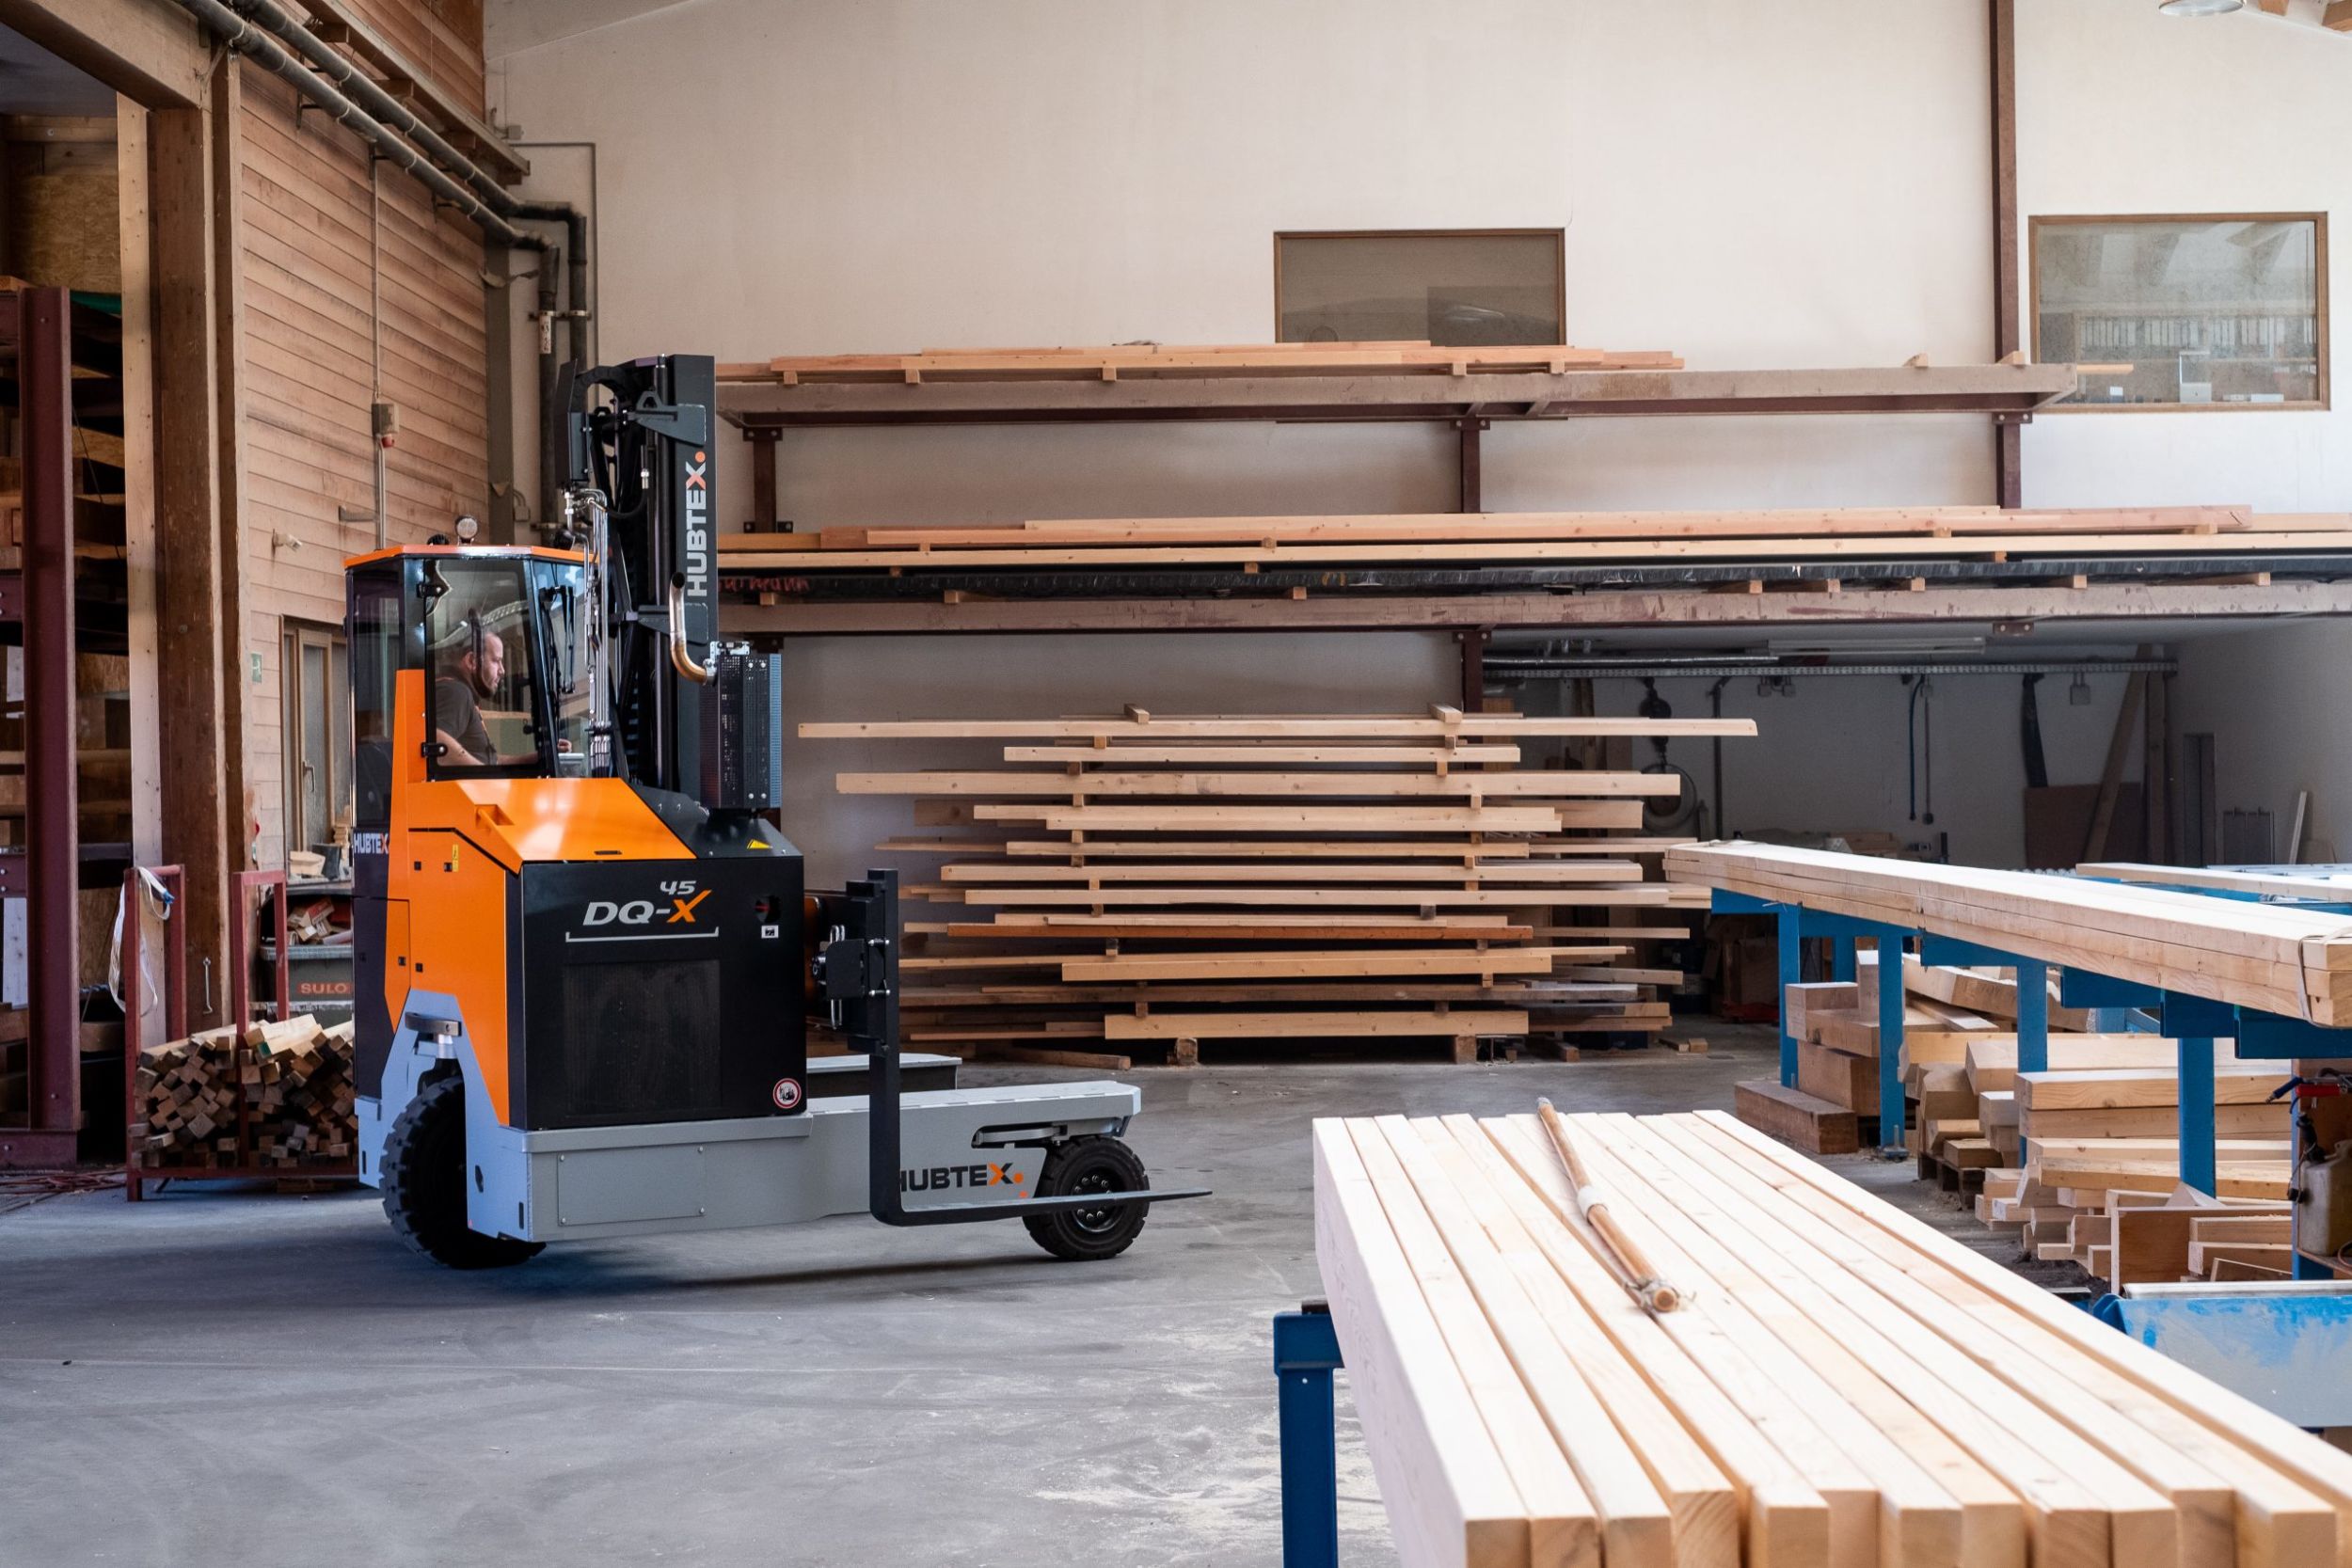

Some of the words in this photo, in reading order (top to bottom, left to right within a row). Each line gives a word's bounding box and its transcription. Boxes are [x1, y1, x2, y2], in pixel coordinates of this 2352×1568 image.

[686, 461, 707, 596] HUBTEX
[354, 832, 389, 854] HUBTEX
[660, 880, 696, 895] 45
[582, 890, 712, 926] DQ-X
[300, 982, 348, 994] SULO
